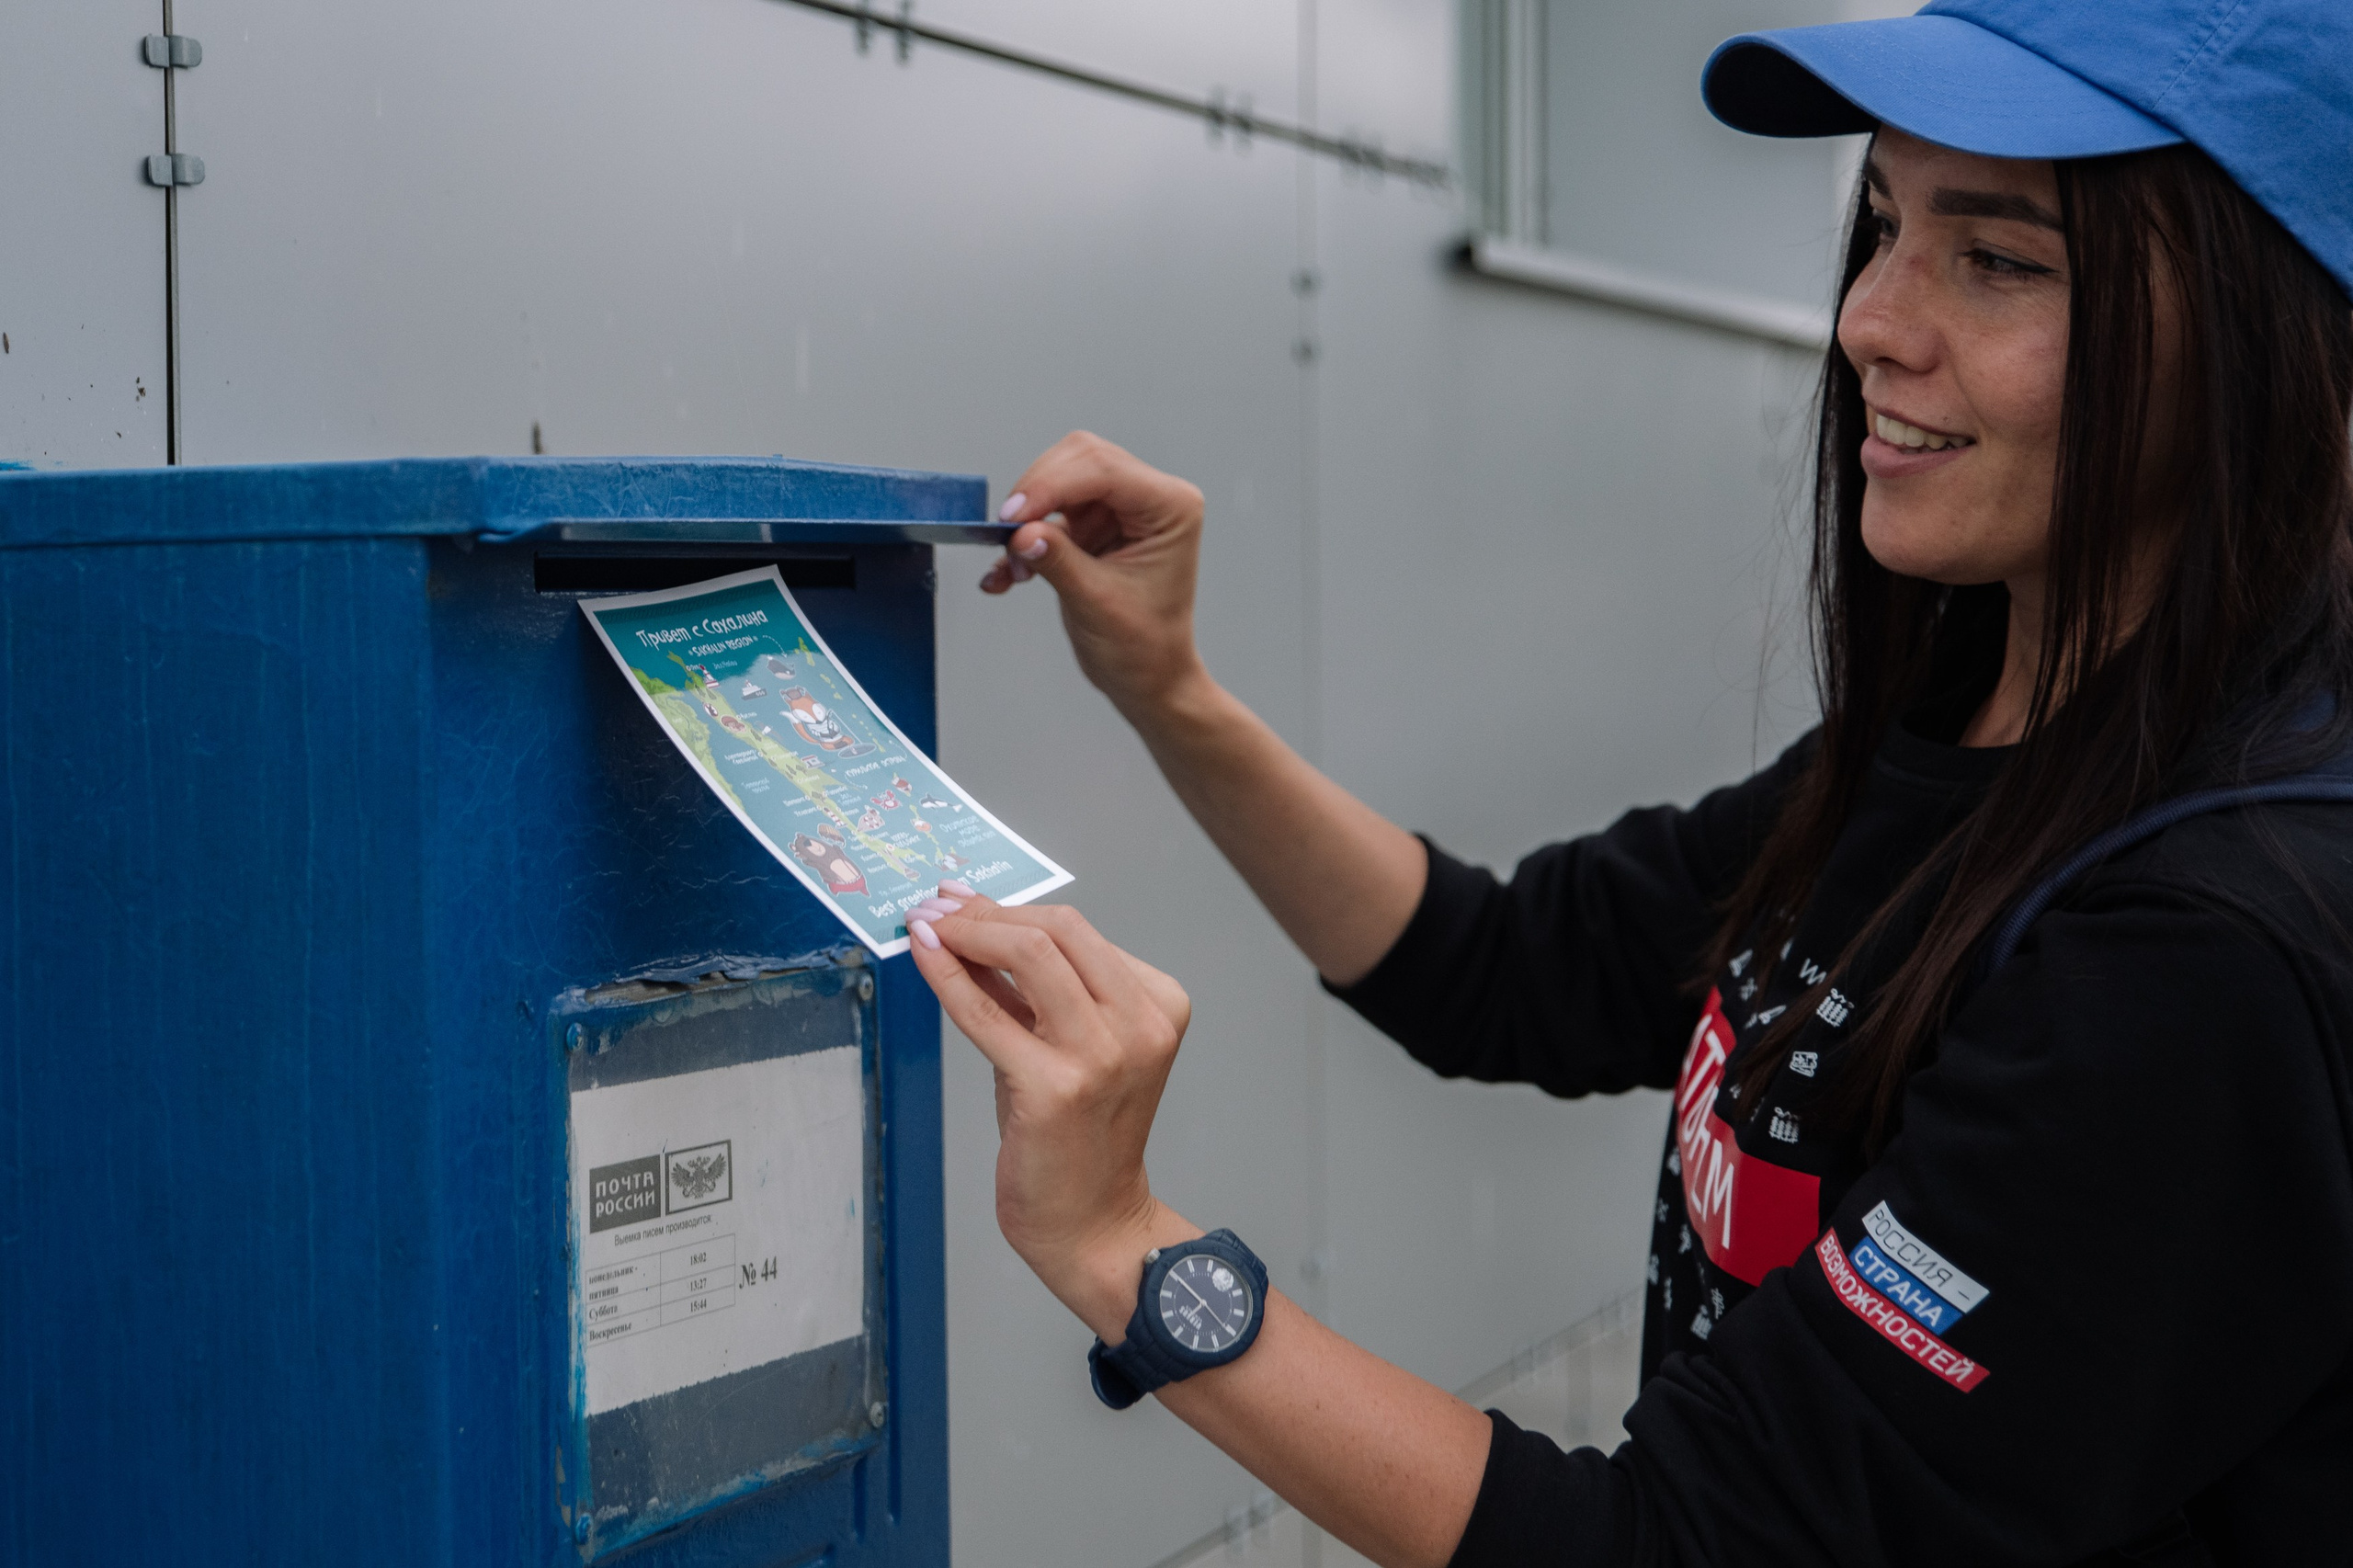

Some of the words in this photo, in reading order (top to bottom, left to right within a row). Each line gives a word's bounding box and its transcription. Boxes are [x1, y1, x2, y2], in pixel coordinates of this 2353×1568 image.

[636, 627, 692, 652] Привет
[702, 609, 769, 635] Сахалина
[692, 642, 726, 657] SAKHALIN
[725, 635, 754, 650] REGION
[965, 859, 1013, 884] Sakhalin
[869, 900, 897, 919] Best
[897, 885, 939, 912] greeting
[596, 1171, 654, 1199] ПОЧТА
[596, 1189, 655, 1219] РОССИИ
[614, 1231, 642, 1246] Выемка
[642, 1226, 665, 1238] писем
[690, 1252, 707, 1267] 18:02
[1869, 1209, 1953, 1289] РОССИЯ
[761, 1256, 779, 1283] 44
[589, 1286, 619, 1301] пятница
[690, 1278, 707, 1292] 13:27
[1854, 1244, 1944, 1327] СТРАНА
[589, 1304, 619, 1322] Суббота
[690, 1298, 707, 1312] 15:44
[1820, 1233, 1976, 1383] ВОЗМОЖНОСТЕЙ
[589, 1322, 632, 1342] Воскресенье
